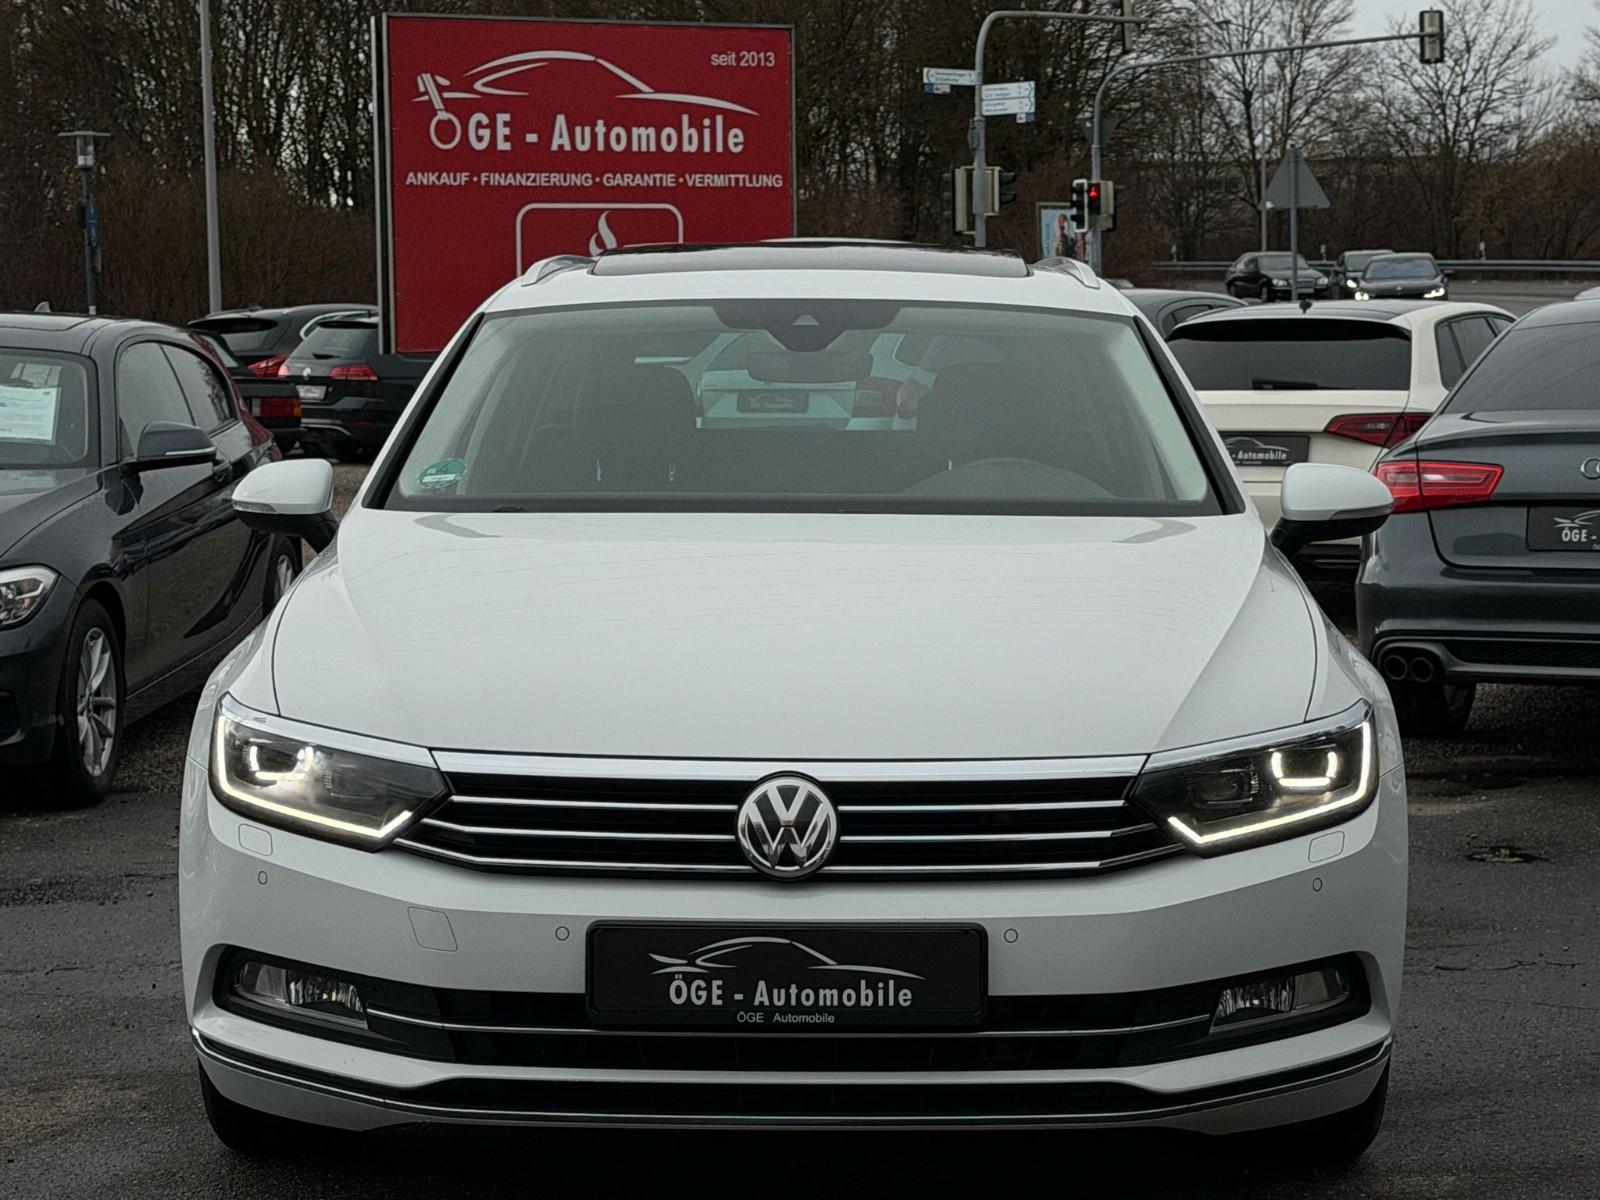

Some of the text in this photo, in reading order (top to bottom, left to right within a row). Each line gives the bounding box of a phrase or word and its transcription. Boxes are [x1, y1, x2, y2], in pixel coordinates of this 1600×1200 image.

[710, 50, 776, 67] seit 2013
[550, 113, 745, 154] Automobile
[405, 171, 783, 188] ANKAUF FINANZIERUNG GARANTIE VERMITTLUNG
[669, 974, 723, 1006] ÖGE
[753, 979, 912, 1007] Automobile
[736, 1011, 835, 1023] ÖGE Automobile
